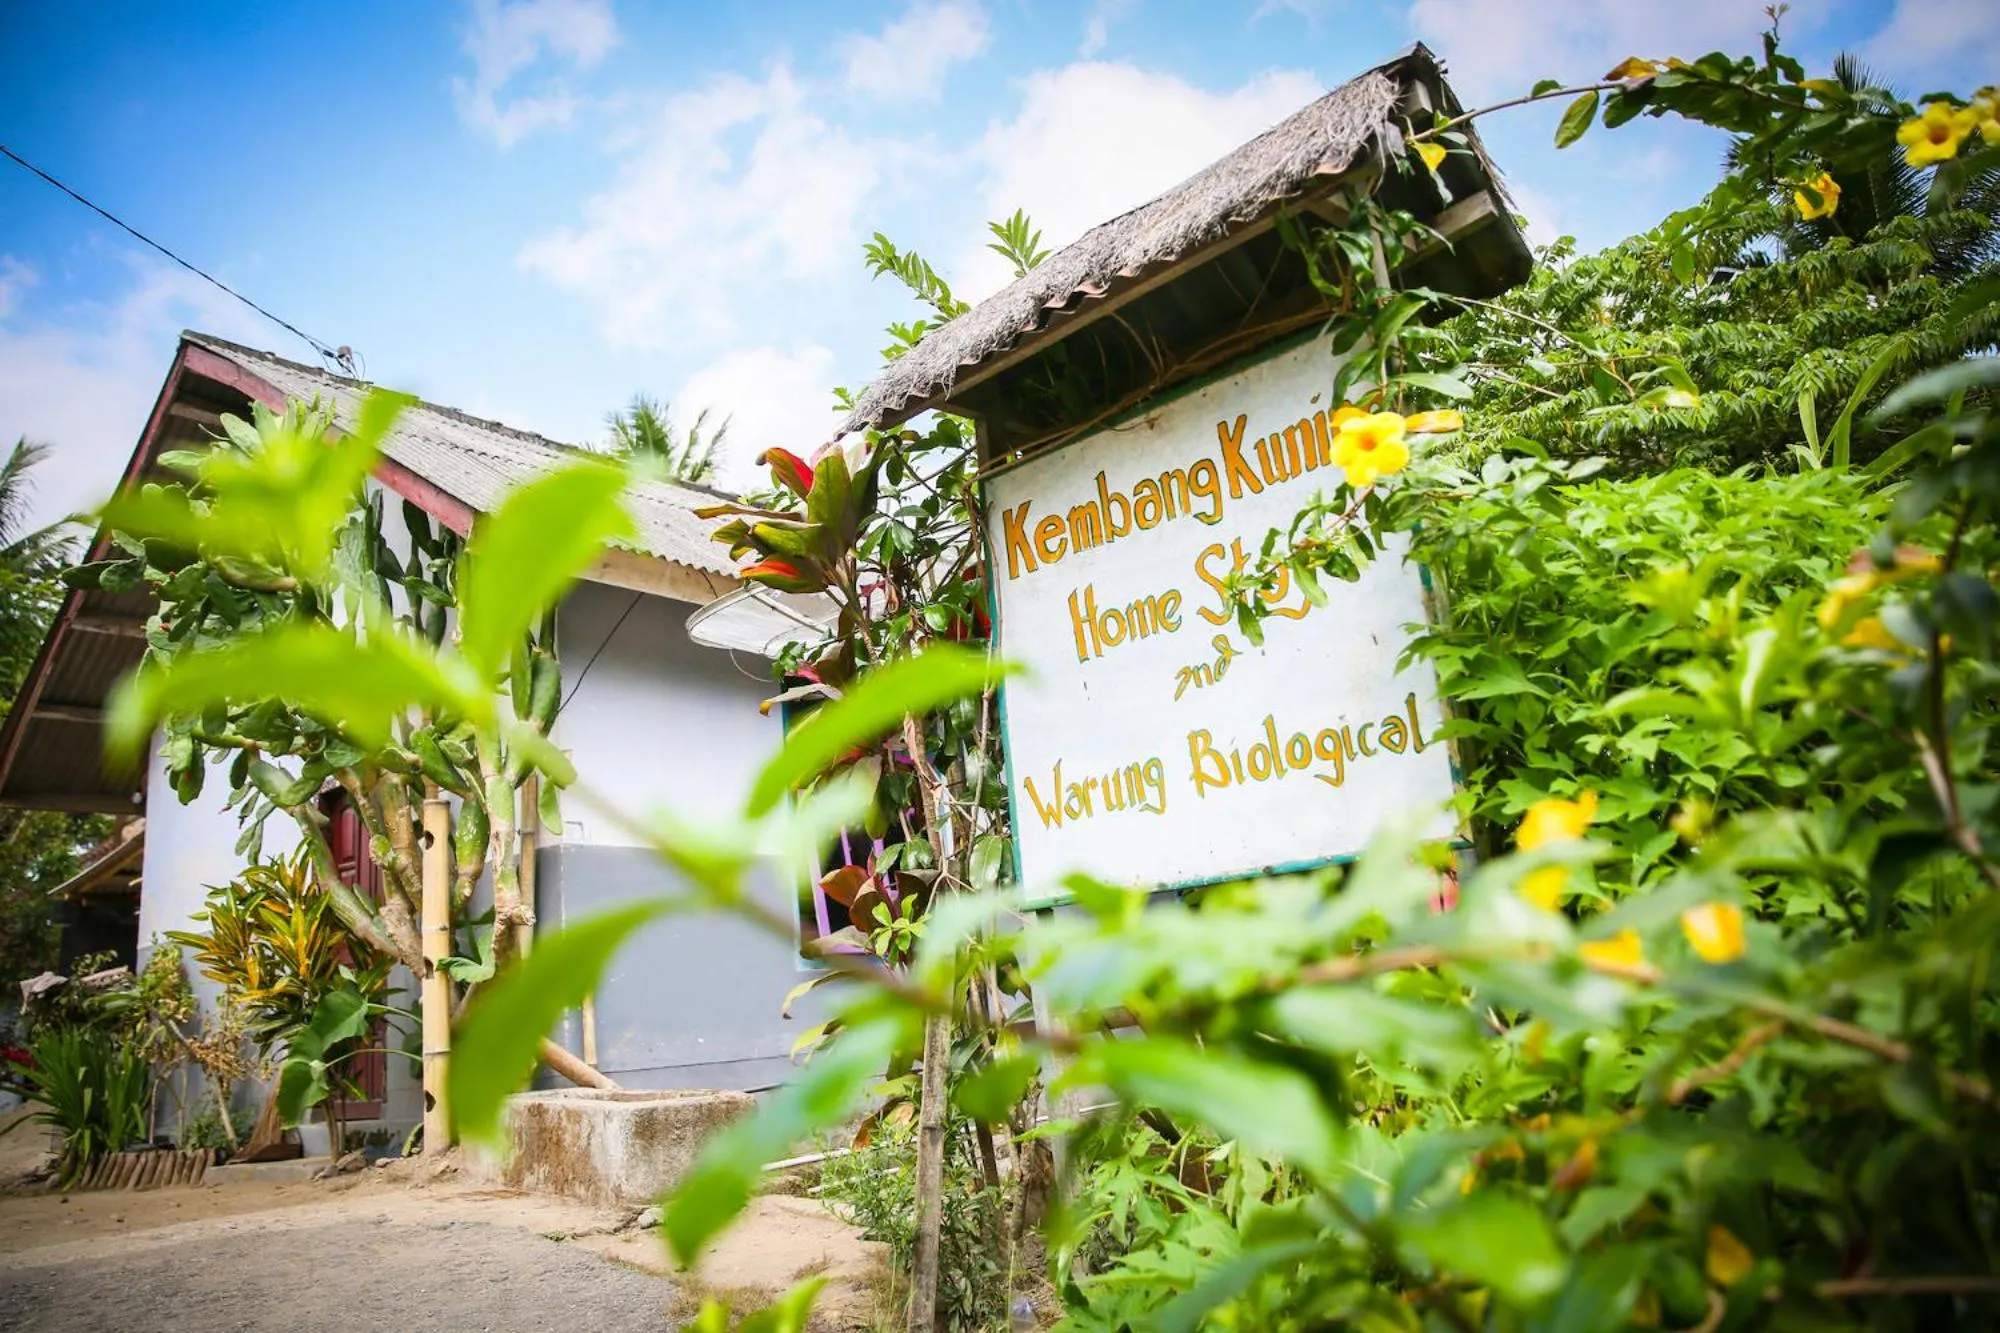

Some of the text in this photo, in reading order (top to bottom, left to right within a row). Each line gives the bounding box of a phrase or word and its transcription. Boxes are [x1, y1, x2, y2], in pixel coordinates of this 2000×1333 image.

[1002, 457, 1223, 580] Kembang
[1067, 583, 1183, 664] Home
[1023, 692, 1429, 830] Warung Biological
